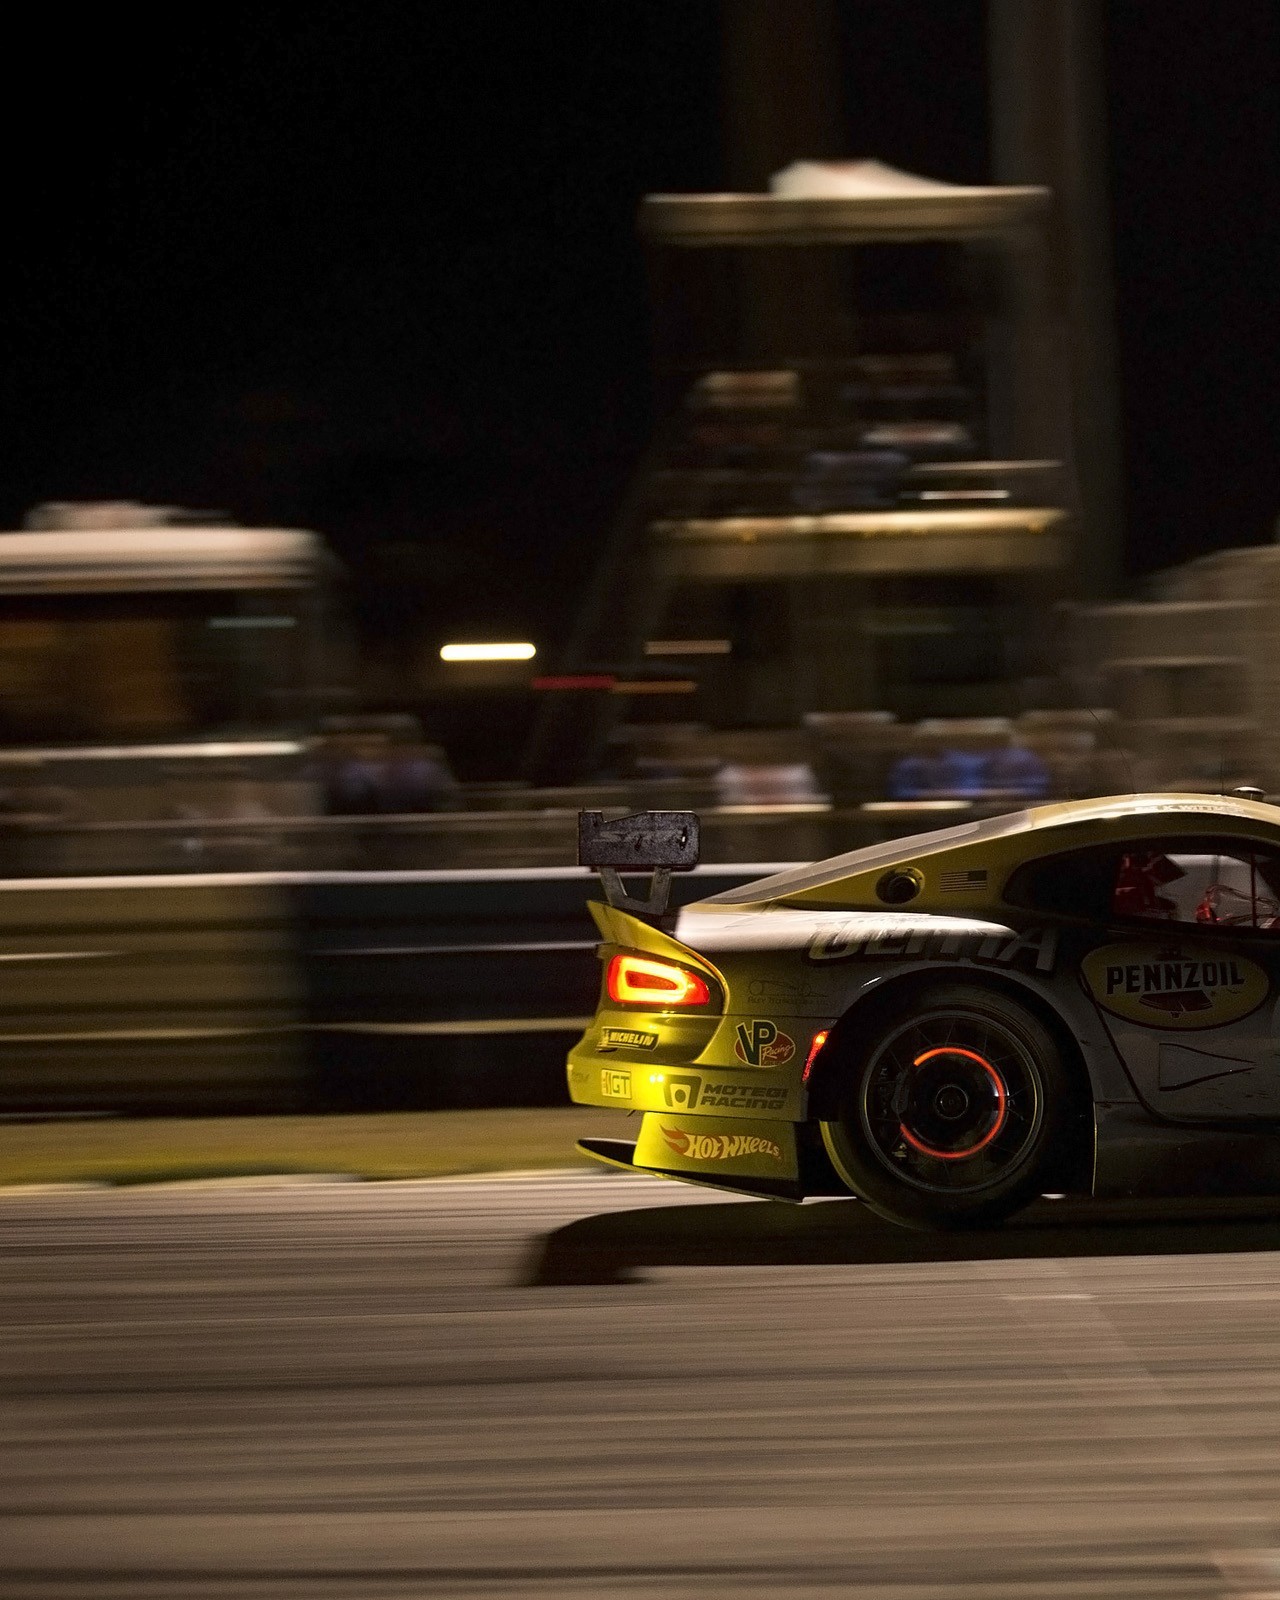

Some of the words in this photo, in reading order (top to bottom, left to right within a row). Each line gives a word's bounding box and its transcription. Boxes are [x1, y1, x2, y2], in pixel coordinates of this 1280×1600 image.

[1106, 961, 1246, 995] PENNZOIL
[609, 1031, 655, 1046] MICHELIN
[735, 1020, 778, 1067] VP
[612, 1075, 630, 1095] GT
[703, 1083, 789, 1098] MOTEGI
[700, 1096, 785, 1110] RACING
